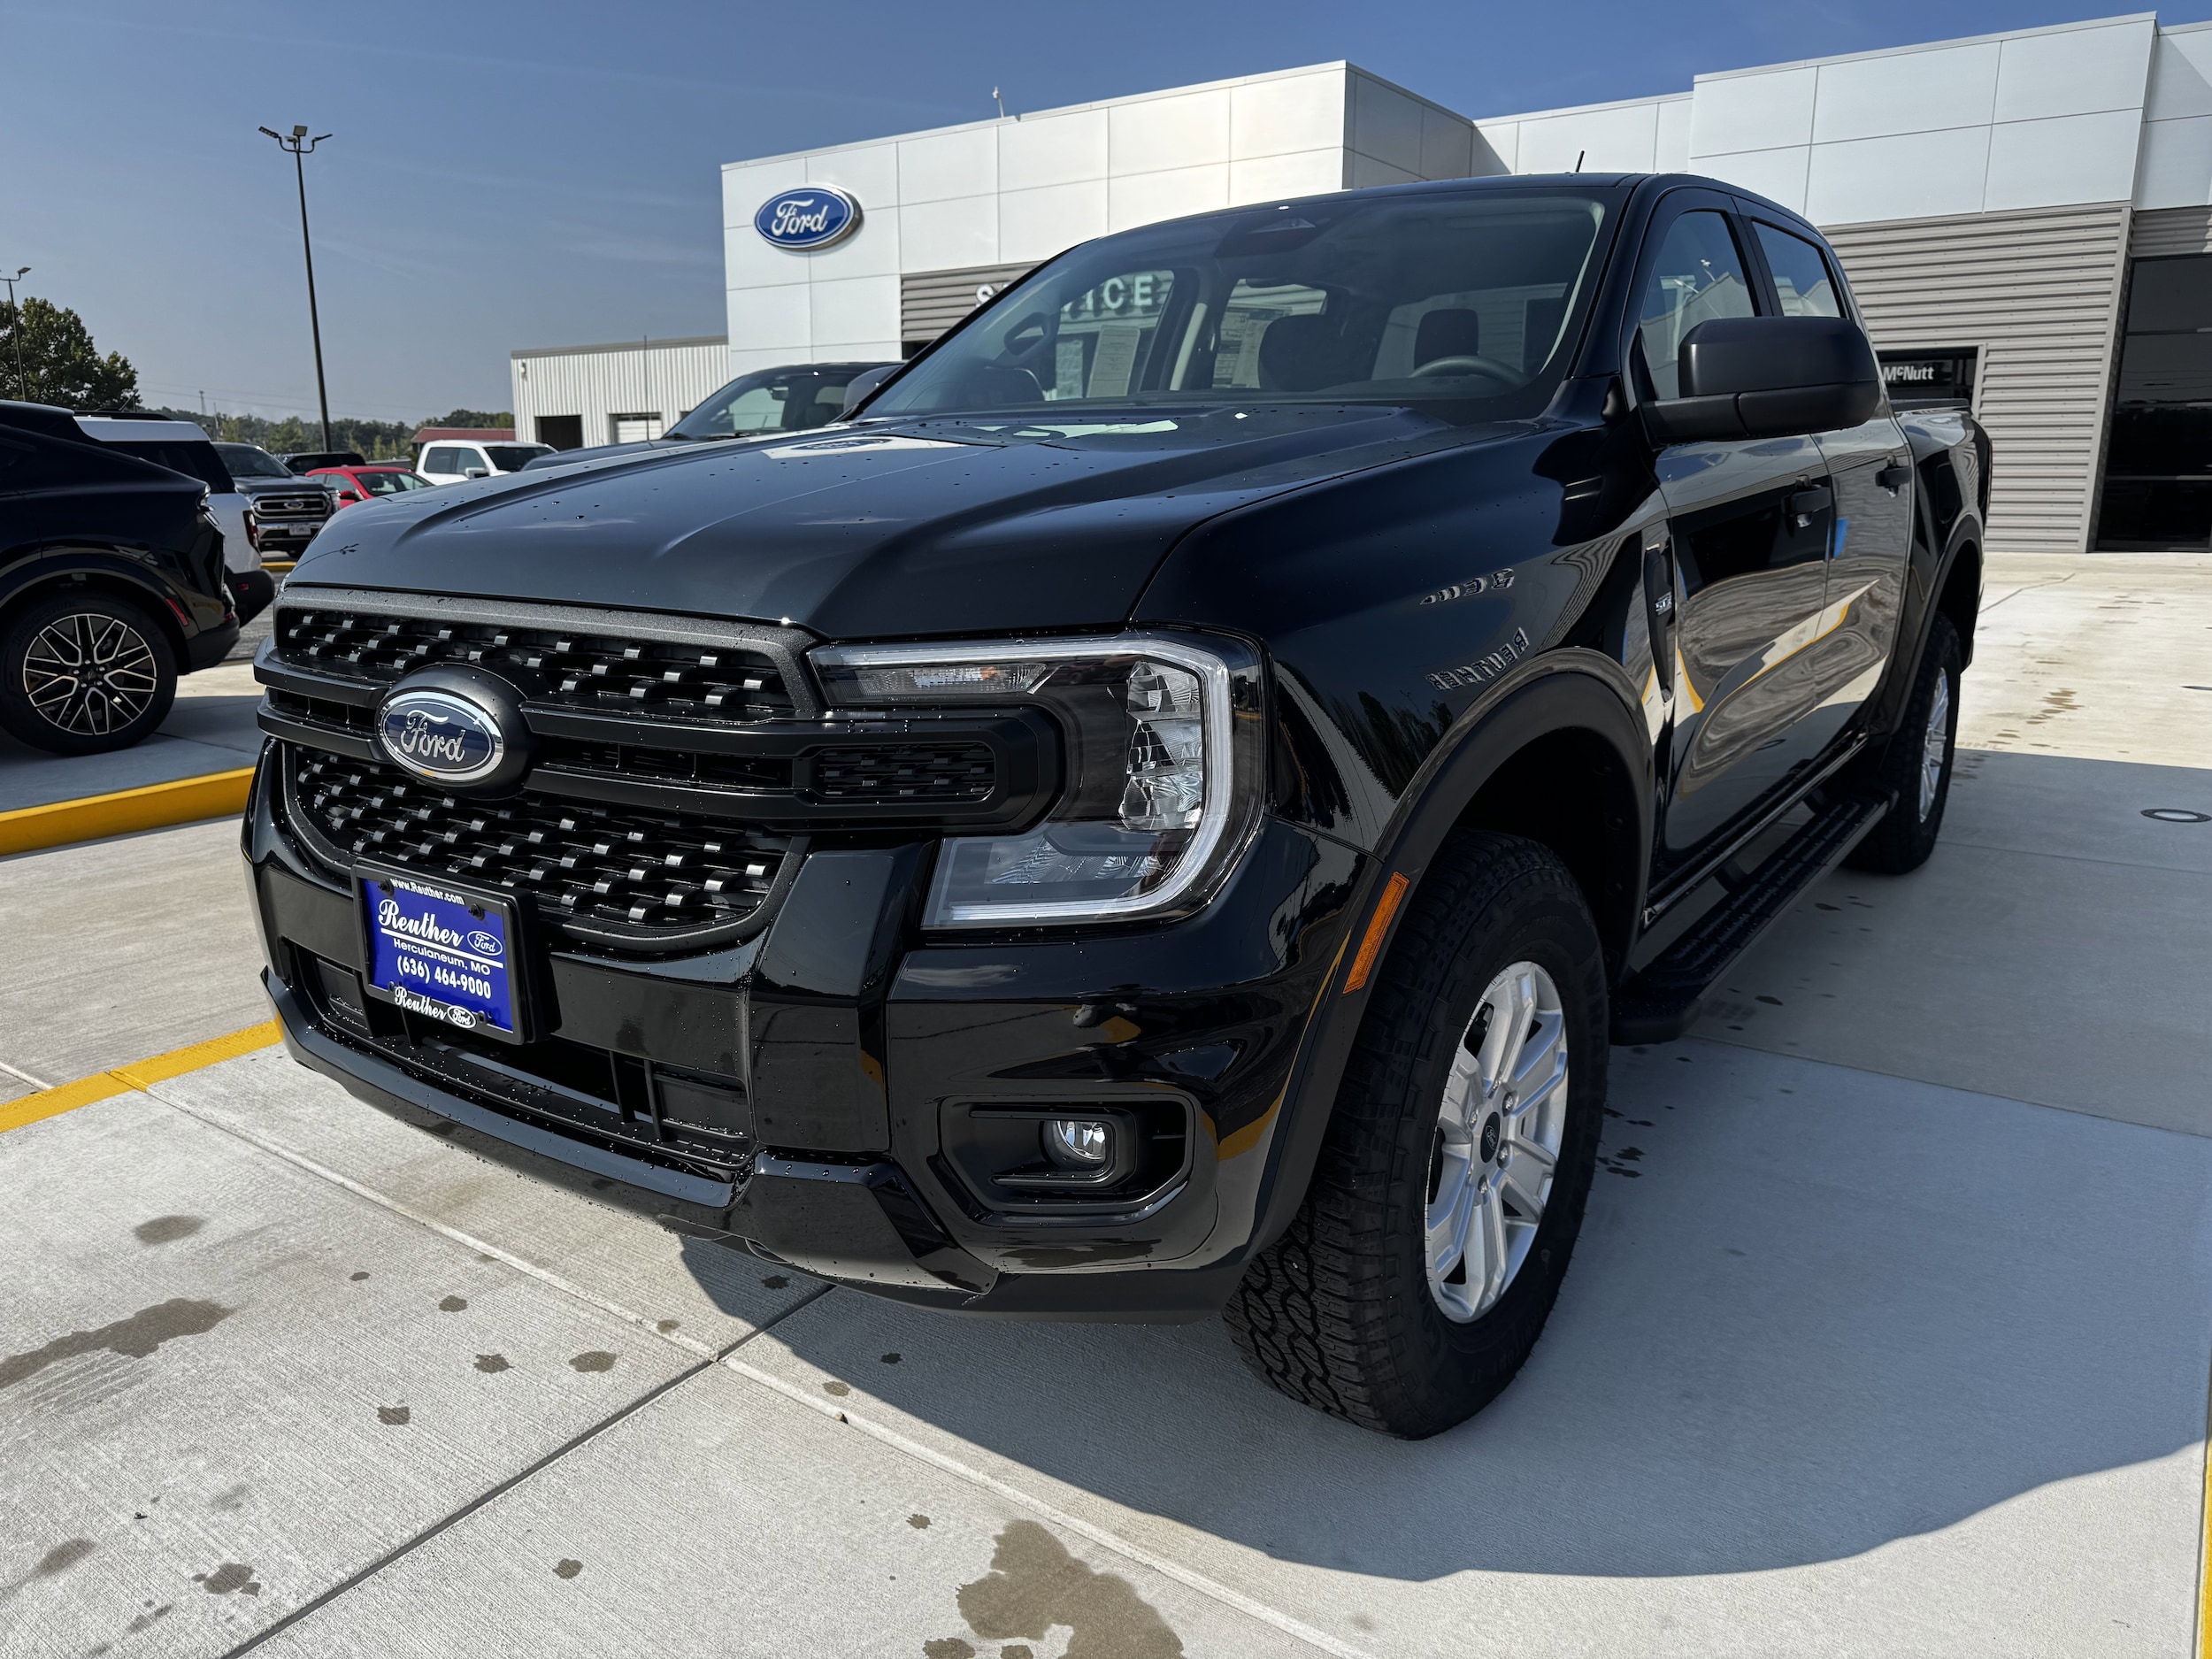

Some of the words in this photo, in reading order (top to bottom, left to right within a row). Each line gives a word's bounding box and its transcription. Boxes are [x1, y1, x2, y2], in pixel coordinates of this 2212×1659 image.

[771, 197, 830, 237] Ford
[1882, 365, 1935, 381] McNutt
[400, 709, 466, 763] Ford
[389, 877, 465, 906] www.Reuther.com
[377, 898, 465, 947] Reuther
[393, 937, 468, 971] Herculaneum,
[470, 961, 491, 975] MO
[473, 932, 497, 953] Ford
[396, 955, 431, 984] (636)
[434, 966, 492, 1000] 464-9000
[394, 986, 448, 1020] Reuther
[451, 1007, 472, 1026] Ford
